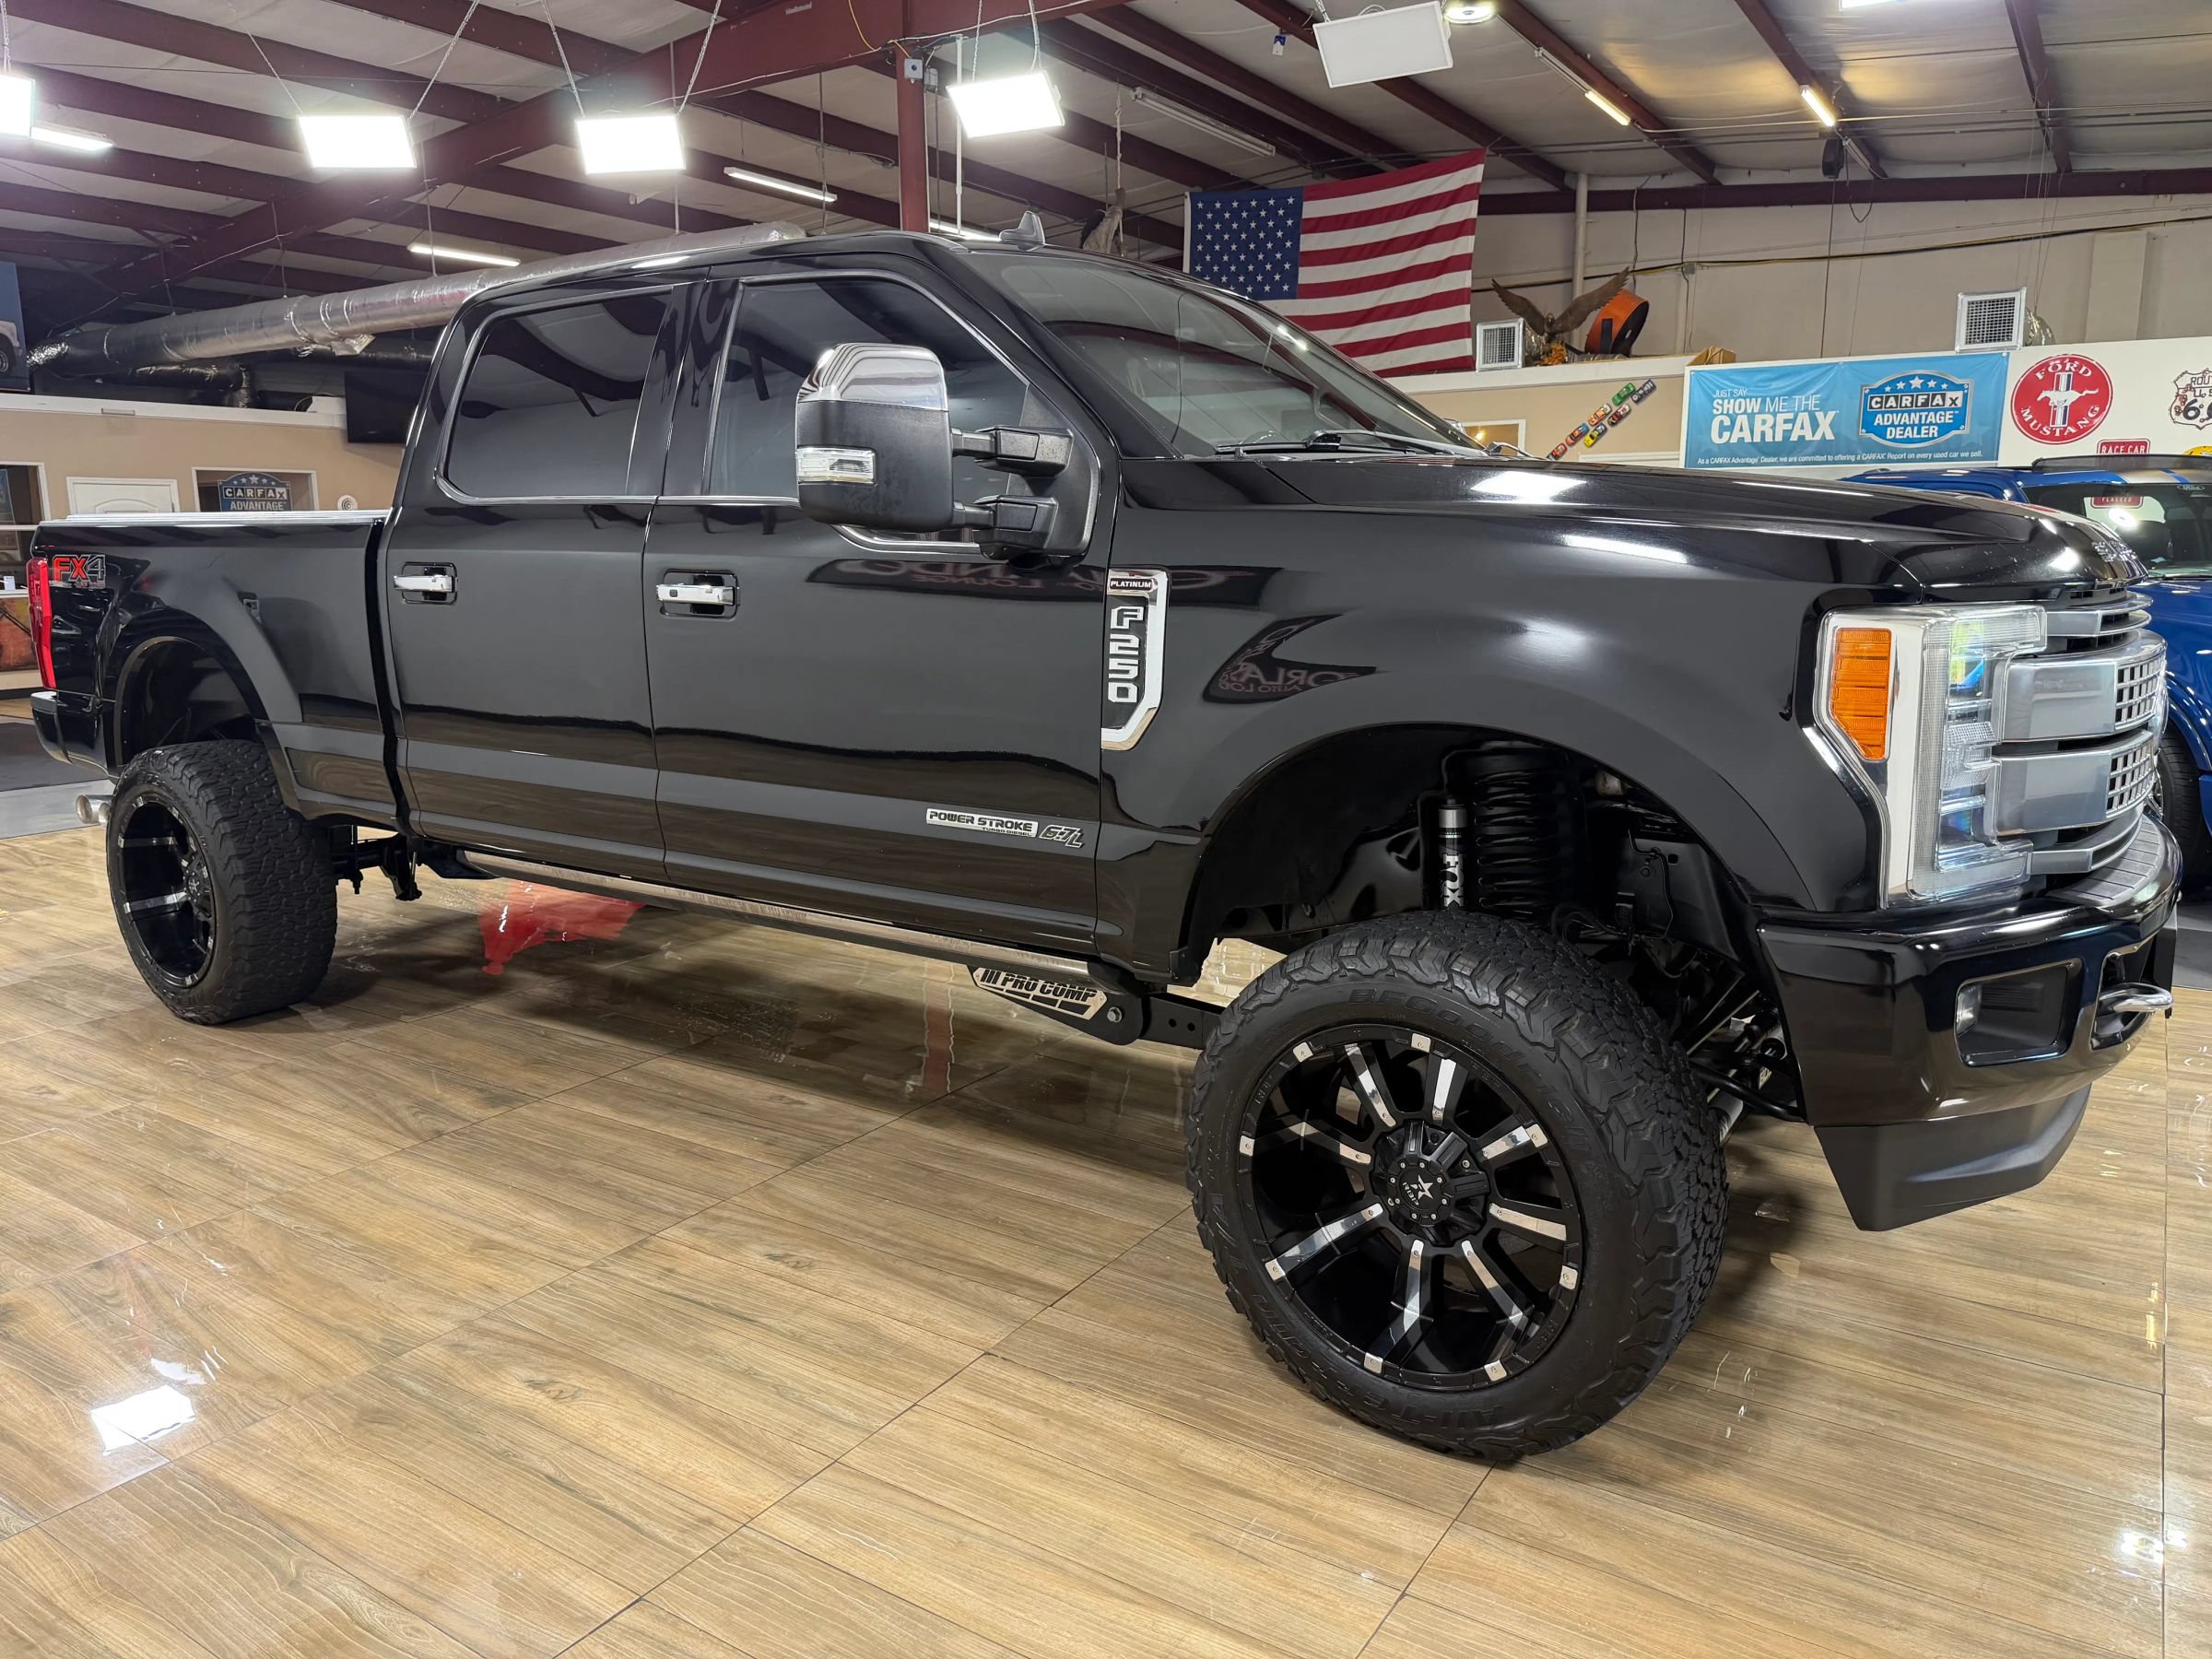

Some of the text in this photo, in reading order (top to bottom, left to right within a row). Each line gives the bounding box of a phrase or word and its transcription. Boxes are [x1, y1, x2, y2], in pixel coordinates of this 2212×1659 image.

[2035, 360, 2092, 380] FORD
[2191, 375, 2212, 385] ROU
[1712, 388, 1747, 397] JUST SAY
[1870, 394, 1959, 408] CARFAX
[1712, 394, 1821, 415] SHOW ME THE
[1874, 411, 1955, 426] ADVANTAGE
[2020, 405, 2100, 437] MUSTANG
[1711, 411, 1836, 444] CARFAX
[1886, 426, 1938, 439] DEALER
[1887, 453, 1906, 461] Report
[2101, 445, 2146, 454] RACE CAR
[224, 488, 286, 500] CARFAX
[230, 501, 285, 511] ADVANTAGE
[53, 555, 106, 582] FX4
[1110, 580, 1152, 588] PLATINUM
[1108, 606, 1145, 703] F250
[929, 810, 1033, 832] POWER STROKE
[1039, 824, 1085, 848] 6.7L
[1440, 853, 1465, 907] FOX
[1001, 973, 1039, 993] PRO
[1040, 982, 1098, 1003] COMP
